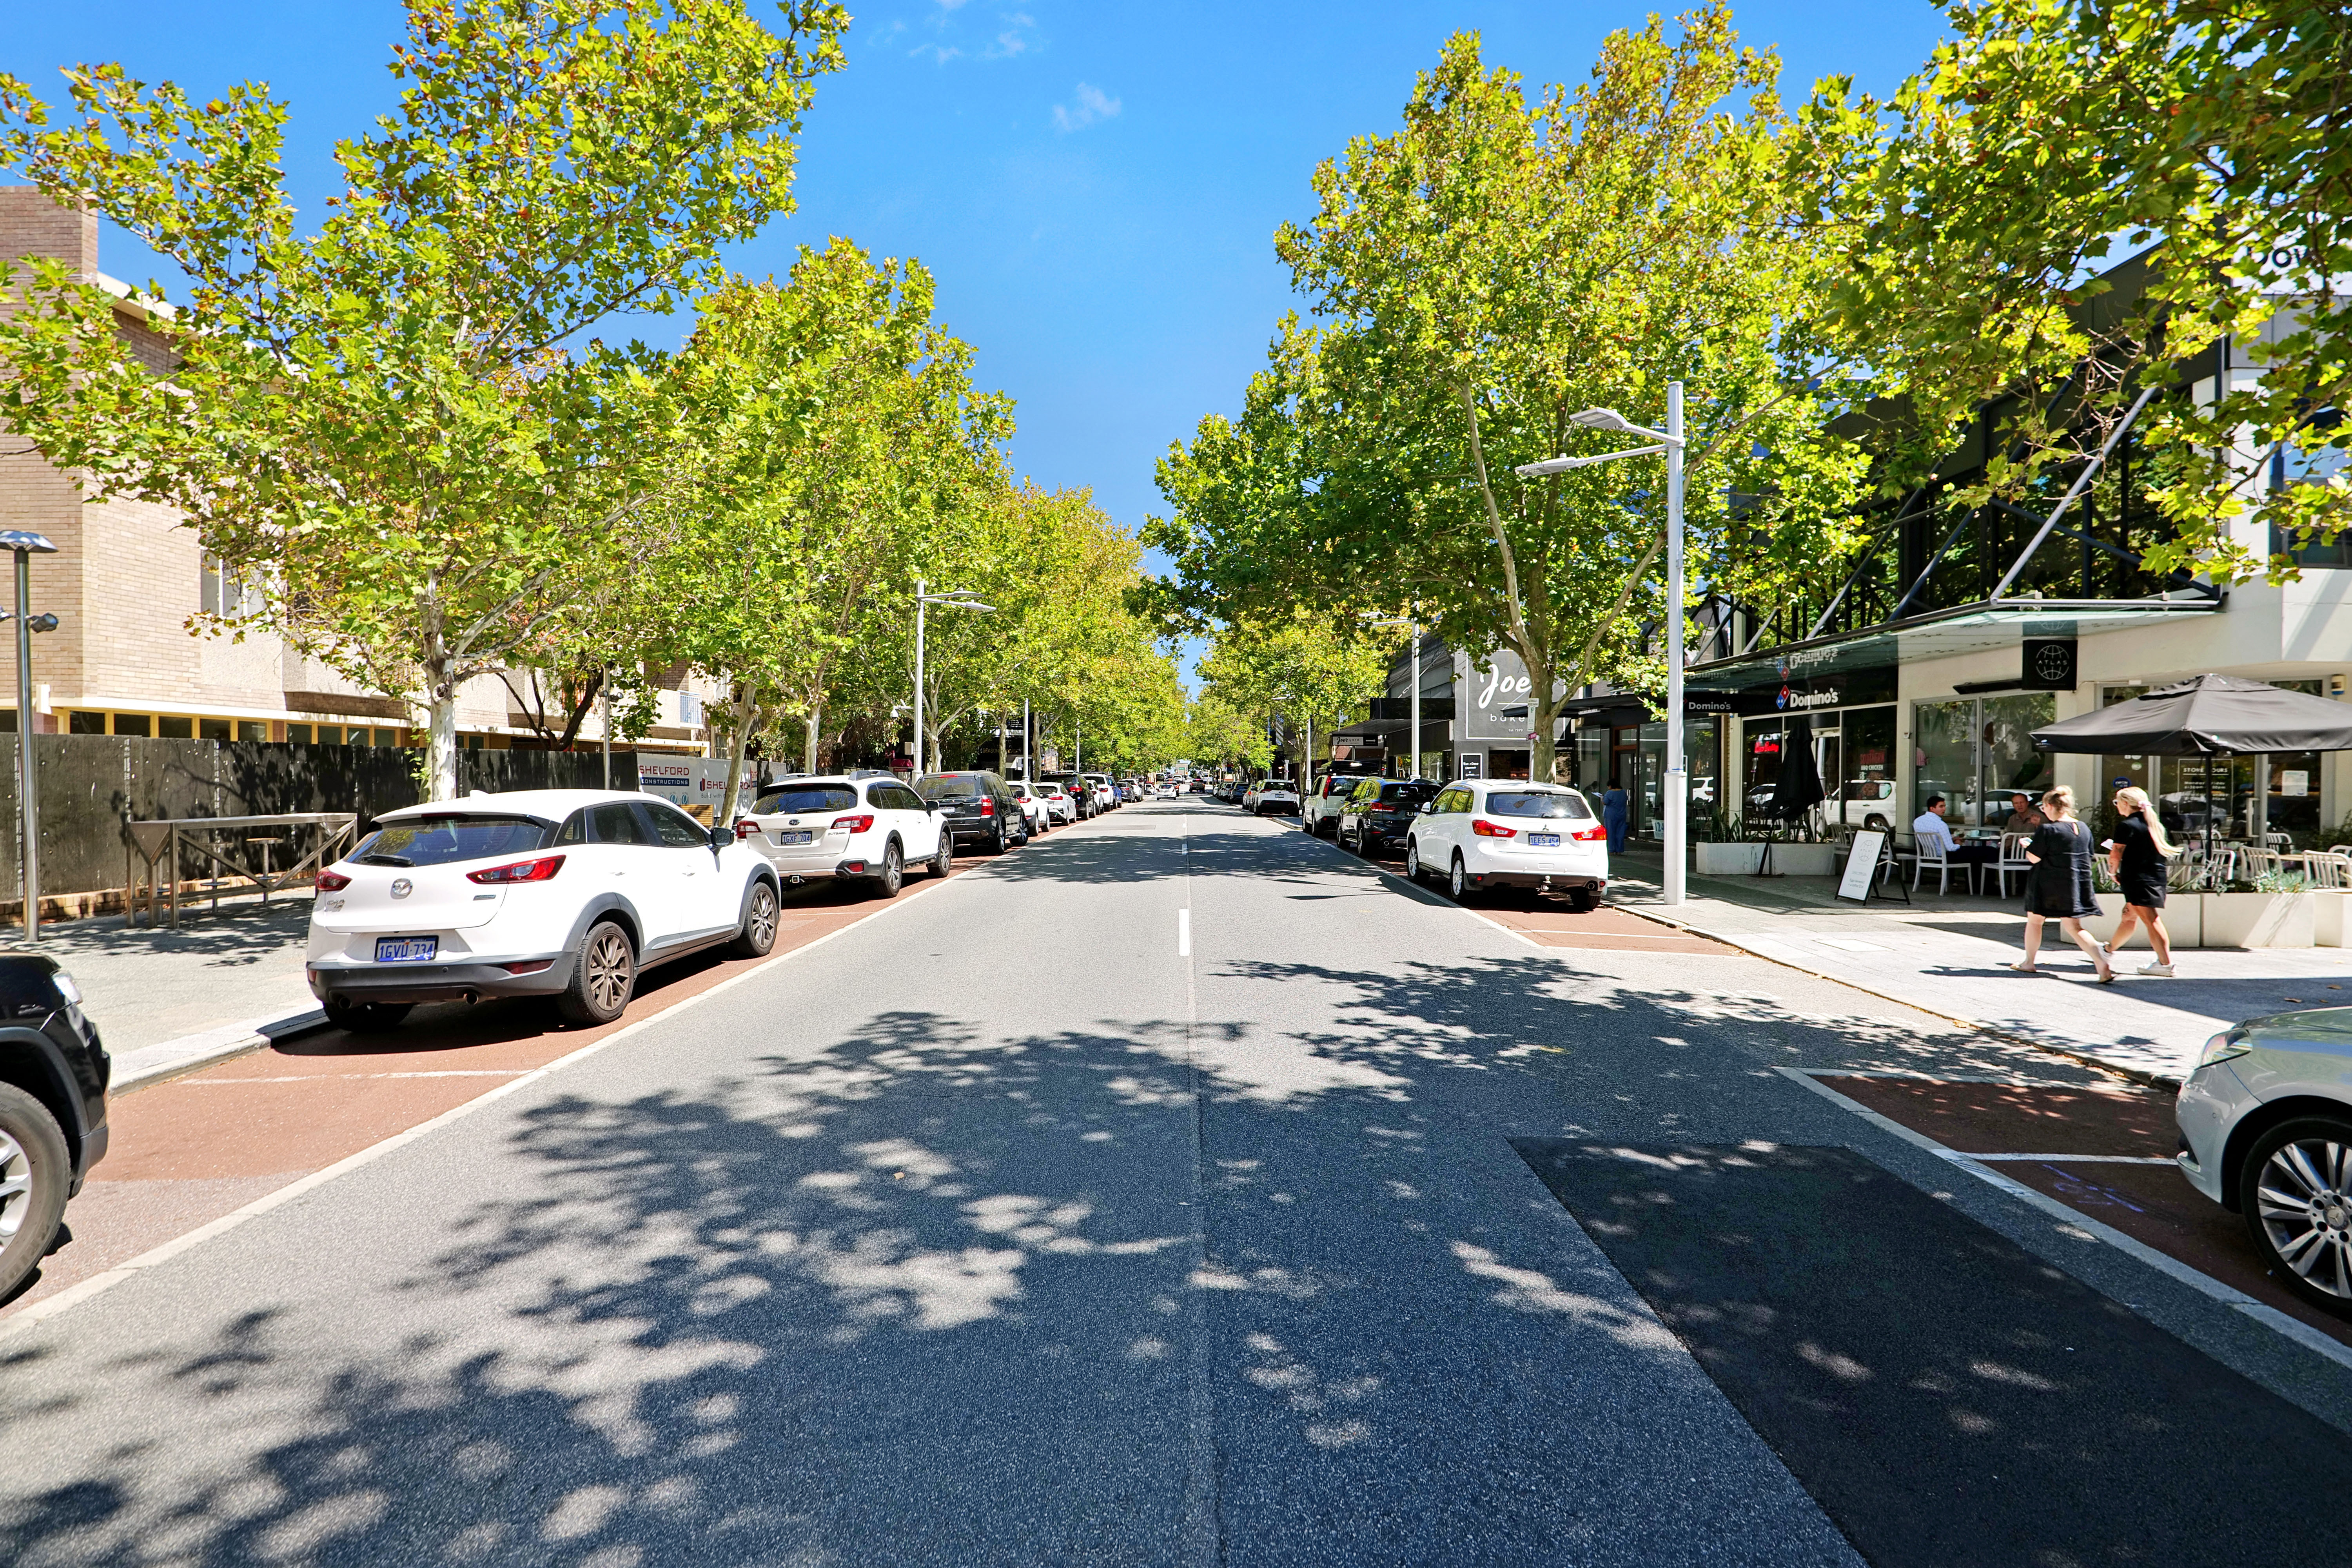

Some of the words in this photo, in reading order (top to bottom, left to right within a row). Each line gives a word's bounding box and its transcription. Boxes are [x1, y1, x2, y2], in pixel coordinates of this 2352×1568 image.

[1479, 664, 1532, 709] Joe
[1790, 687, 1838, 708] Domino's
[1490, 713, 1525, 722] bake
[639, 766, 689, 775] SHELFORD
[707, 781, 749, 789] SHELRD
